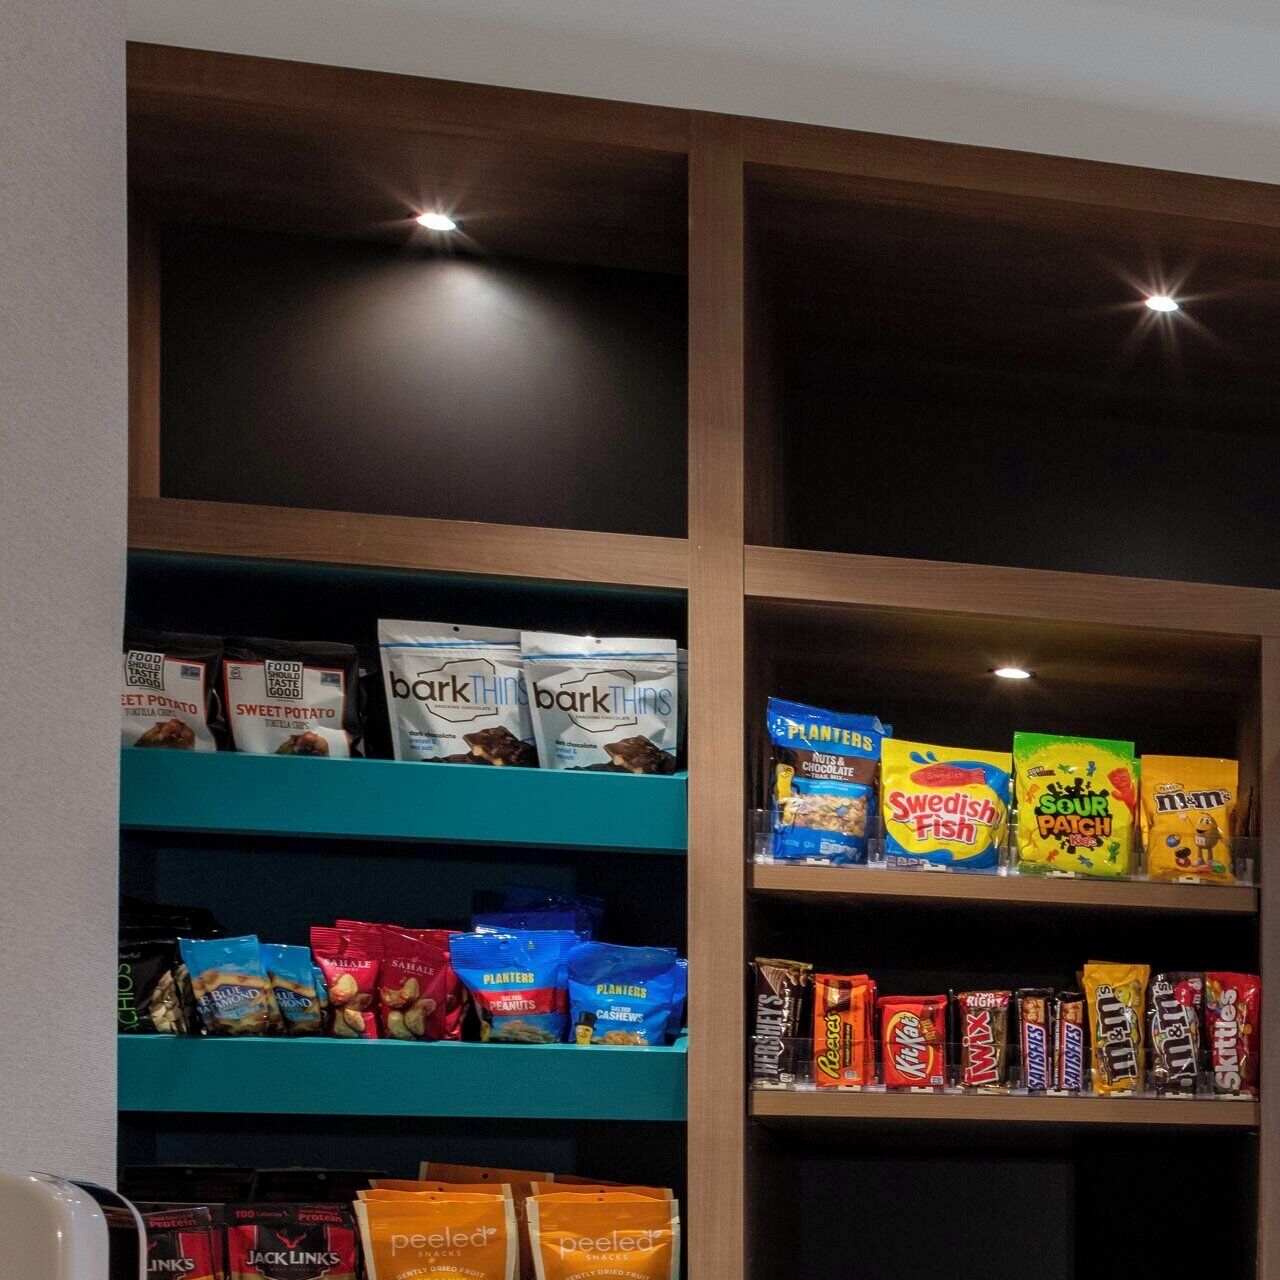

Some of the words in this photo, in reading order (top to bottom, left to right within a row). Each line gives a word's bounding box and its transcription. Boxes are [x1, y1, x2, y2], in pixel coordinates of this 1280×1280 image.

[129, 652, 161, 664] FOOD
[128, 660, 160, 672] SHOULD
[268, 663, 300, 672] FOOD
[129, 669, 160, 680] TASTE
[268, 671, 300, 680] SHOULD
[129, 676, 161, 689] GOOD
[269, 679, 299, 688] TASTE
[269, 687, 299, 697] GOOD
[148, 695, 197, 714] POTATO
[236, 704, 281, 717] SWEET
[285, 705, 335, 719] POTATO
[788, 724, 873, 751] PLANTERS
[813, 753, 837, 764] NUTS
[837, 756, 844, 765] &
[802, 761, 855, 777] CHOCOLATE
[889, 791, 996, 823] Swedish
[1039, 795, 1108, 816] SOUR
[914, 815, 977, 844] Fish
[1037, 815, 1112, 838] PATCH
[1069, 834, 1096, 847] Kids
[323, 959, 371, 968] SAHALE
[392, 960, 434, 976] SAHALE
[483, 972, 534, 984] PLANTERS
[212, 986, 242, 999] BLUE
[596, 984, 646, 998] PLANTERS
[490, 1000, 536, 1011] PEANUTS
[967, 997, 1002, 1007] RIGHT
[596, 1010, 644, 1023] CASHEWS
[754, 994, 783, 1075] HERSHEY'S
[1028, 1024, 1045, 1089] SATISFIES
[299, 1213, 342, 1222] Protein
[392, 1227, 487, 1256] peeled
[560, 1230, 653, 1259] peeled
[247, 1251, 289, 1265] JACK
[290, 1251, 340, 1265] LINK'S
[430, 1265, 457, 1273] DRIED
[460, 1268, 485, 1279] FRUIT
